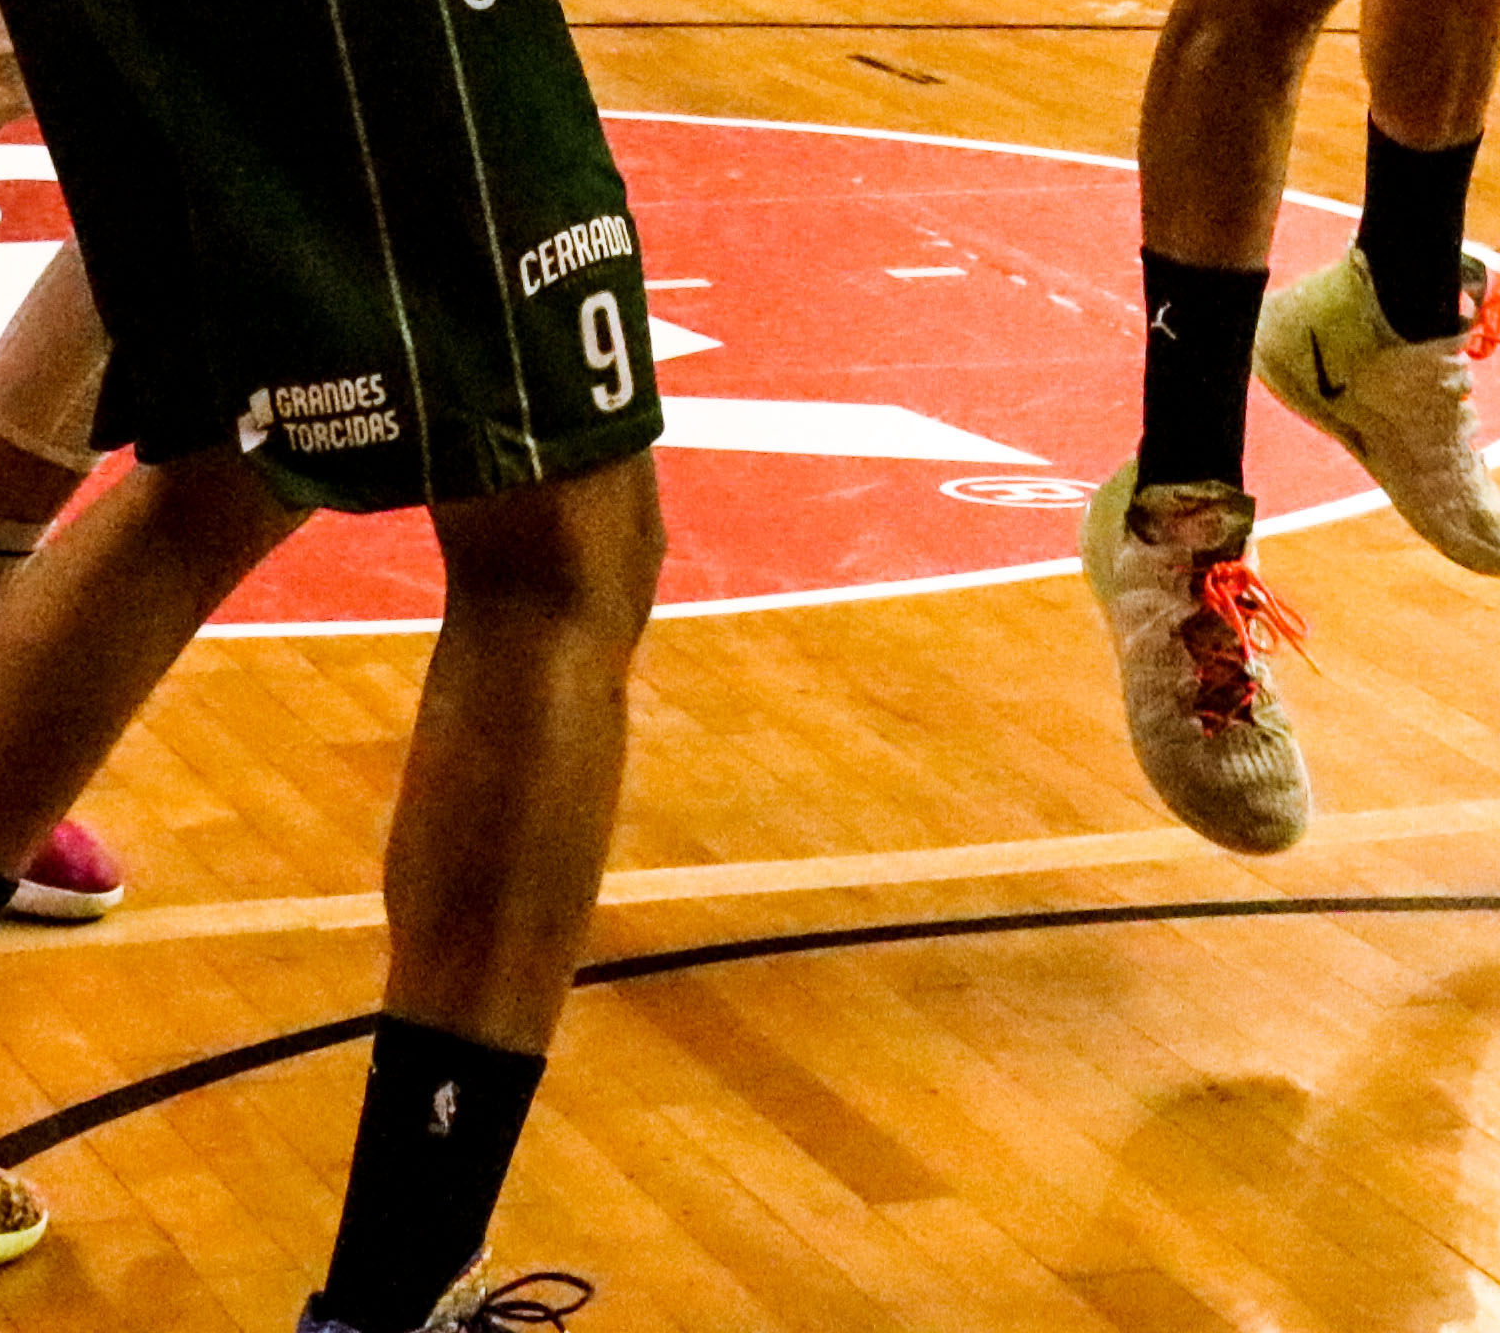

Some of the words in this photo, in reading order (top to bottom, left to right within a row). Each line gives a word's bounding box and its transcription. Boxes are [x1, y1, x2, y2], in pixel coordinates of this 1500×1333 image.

[519, 214, 633, 297] CERRADO
[579, 289, 635, 412] 9
[275, 373, 387, 420] GRANDES
[283, 410, 400, 454] TORCIDAS
